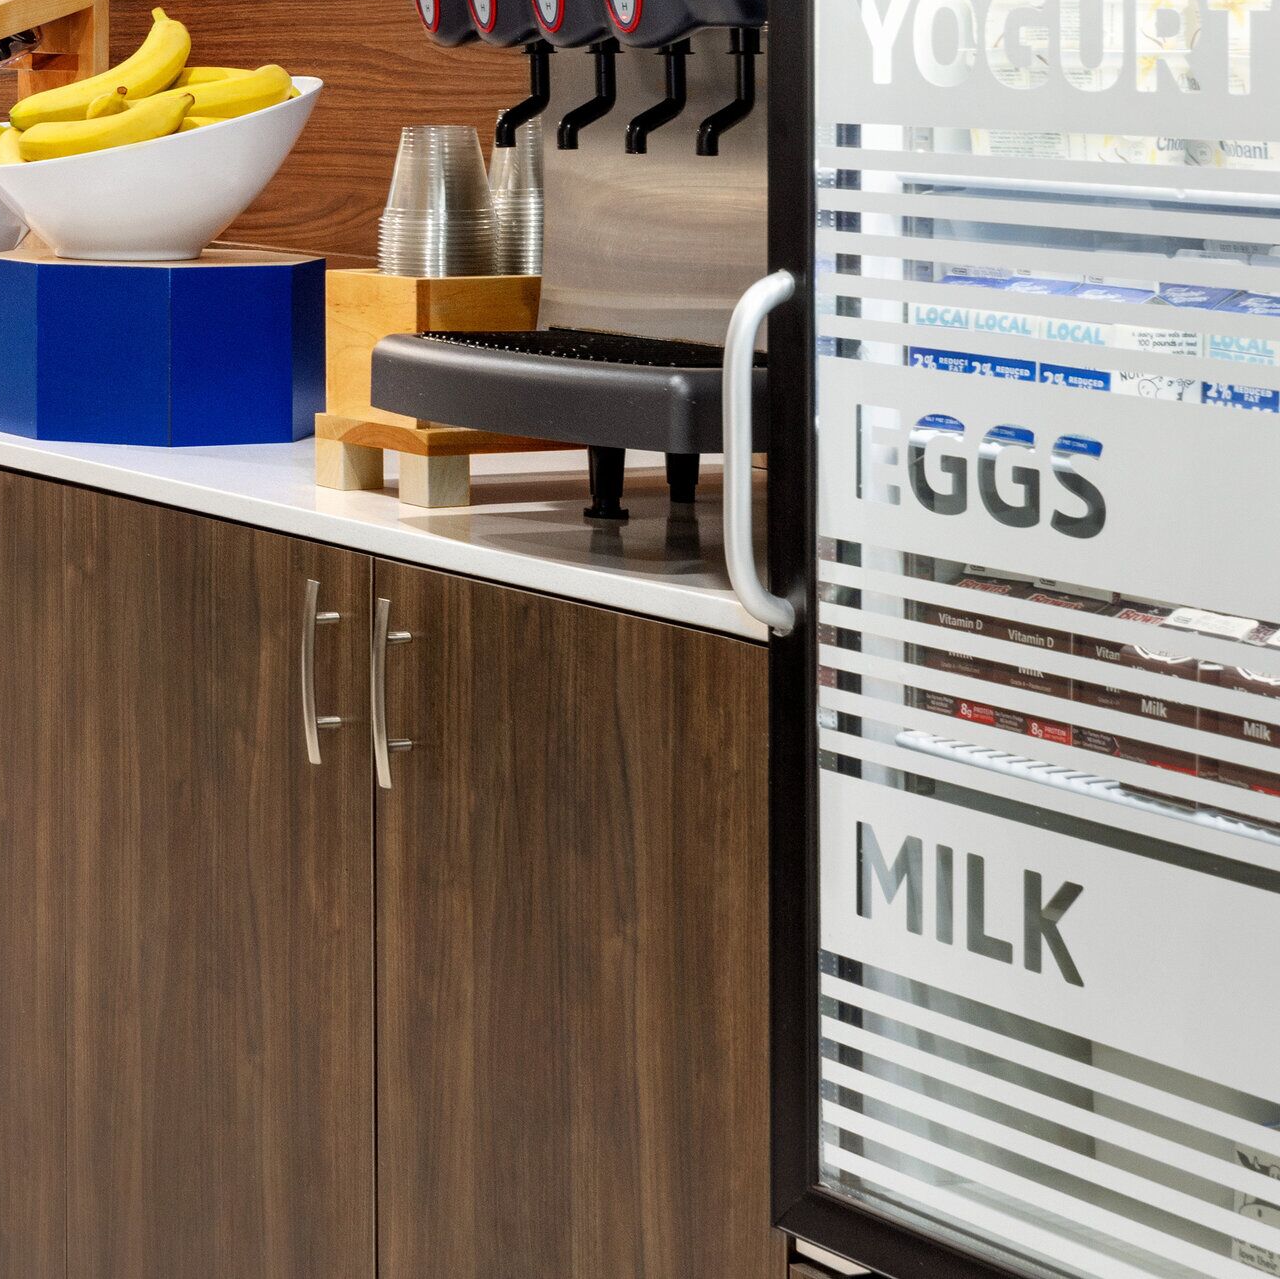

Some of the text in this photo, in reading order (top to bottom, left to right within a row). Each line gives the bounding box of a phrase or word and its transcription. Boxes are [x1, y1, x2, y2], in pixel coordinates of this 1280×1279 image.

[975, 311, 1032, 335] LOCAL
[1046, 320, 1105, 345] LOCAL
[1209, 334, 1275, 355] LOCAL
[914, 354, 938, 370] 2%
[949, 364, 964, 373] FAT
[995, 365, 1030, 376] REDUCED
[1068, 375, 1104, 388] REDUCED
[1206, 383, 1273, 400] 2% REDUCED
[1244, 393, 1261, 403] FAT
[856, 404, 1106, 539] EGGS
[938, 612, 983, 630] Vitamin D
[1008, 628, 1054, 648] Vitamin D
[960, 702, 972, 718] 8g
[1141, 698, 1168, 718] Milk
[1031, 722, 1066, 738] 8g PROTEIN
[1243, 721, 1271, 742] Milk
[856, 820, 1085, 988] MILK
